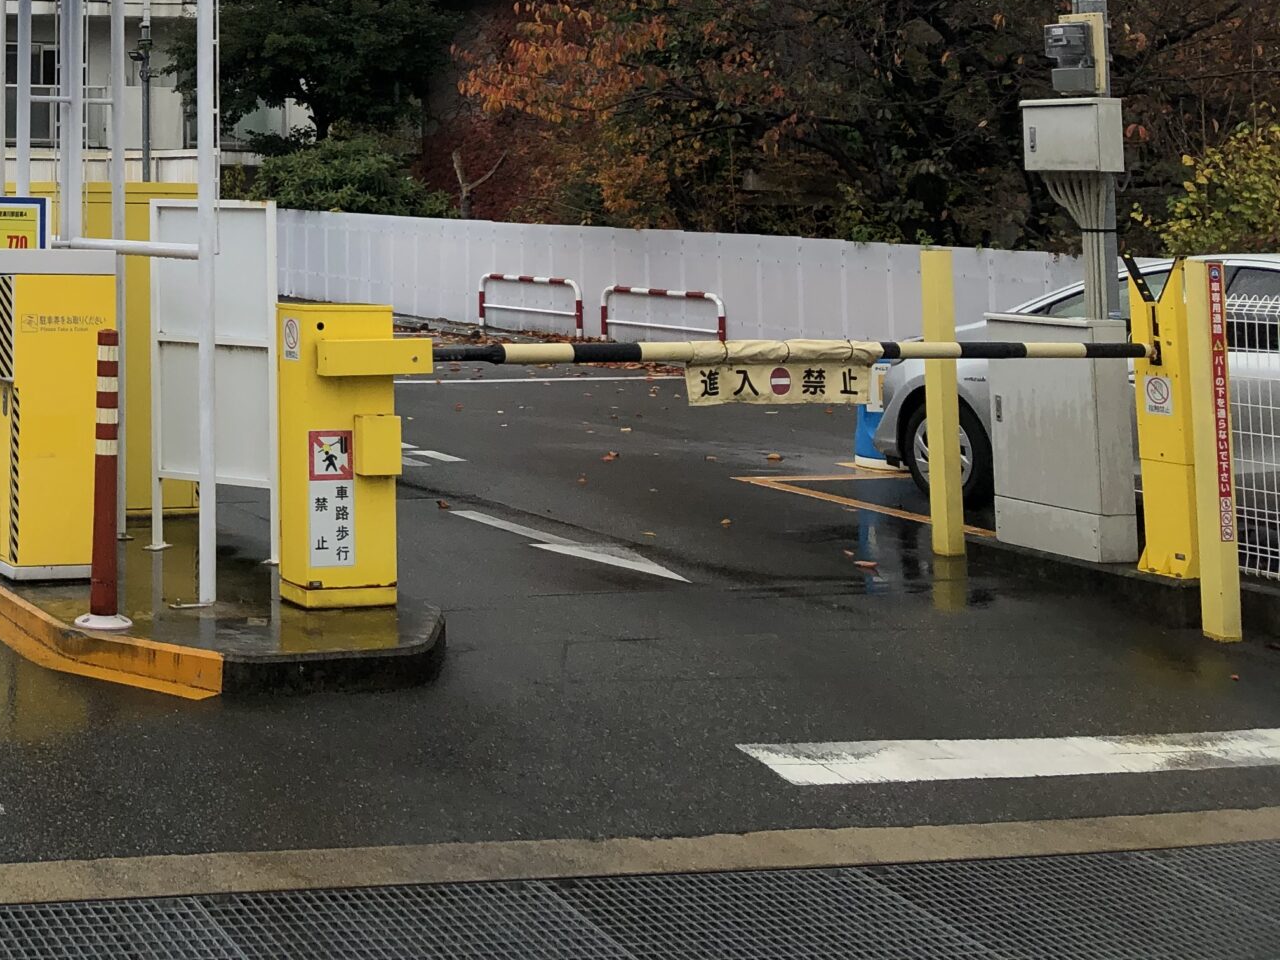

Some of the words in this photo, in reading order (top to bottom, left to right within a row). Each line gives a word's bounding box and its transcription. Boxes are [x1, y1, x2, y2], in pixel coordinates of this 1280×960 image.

[699, 369, 760, 397] 進入
[801, 368, 859, 396] 禁止
[1214, 355, 1230, 493] バーの下を通らないで下さい
[314, 496, 329, 550] 禁止
[335, 485, 350, 561] 車路歩行
